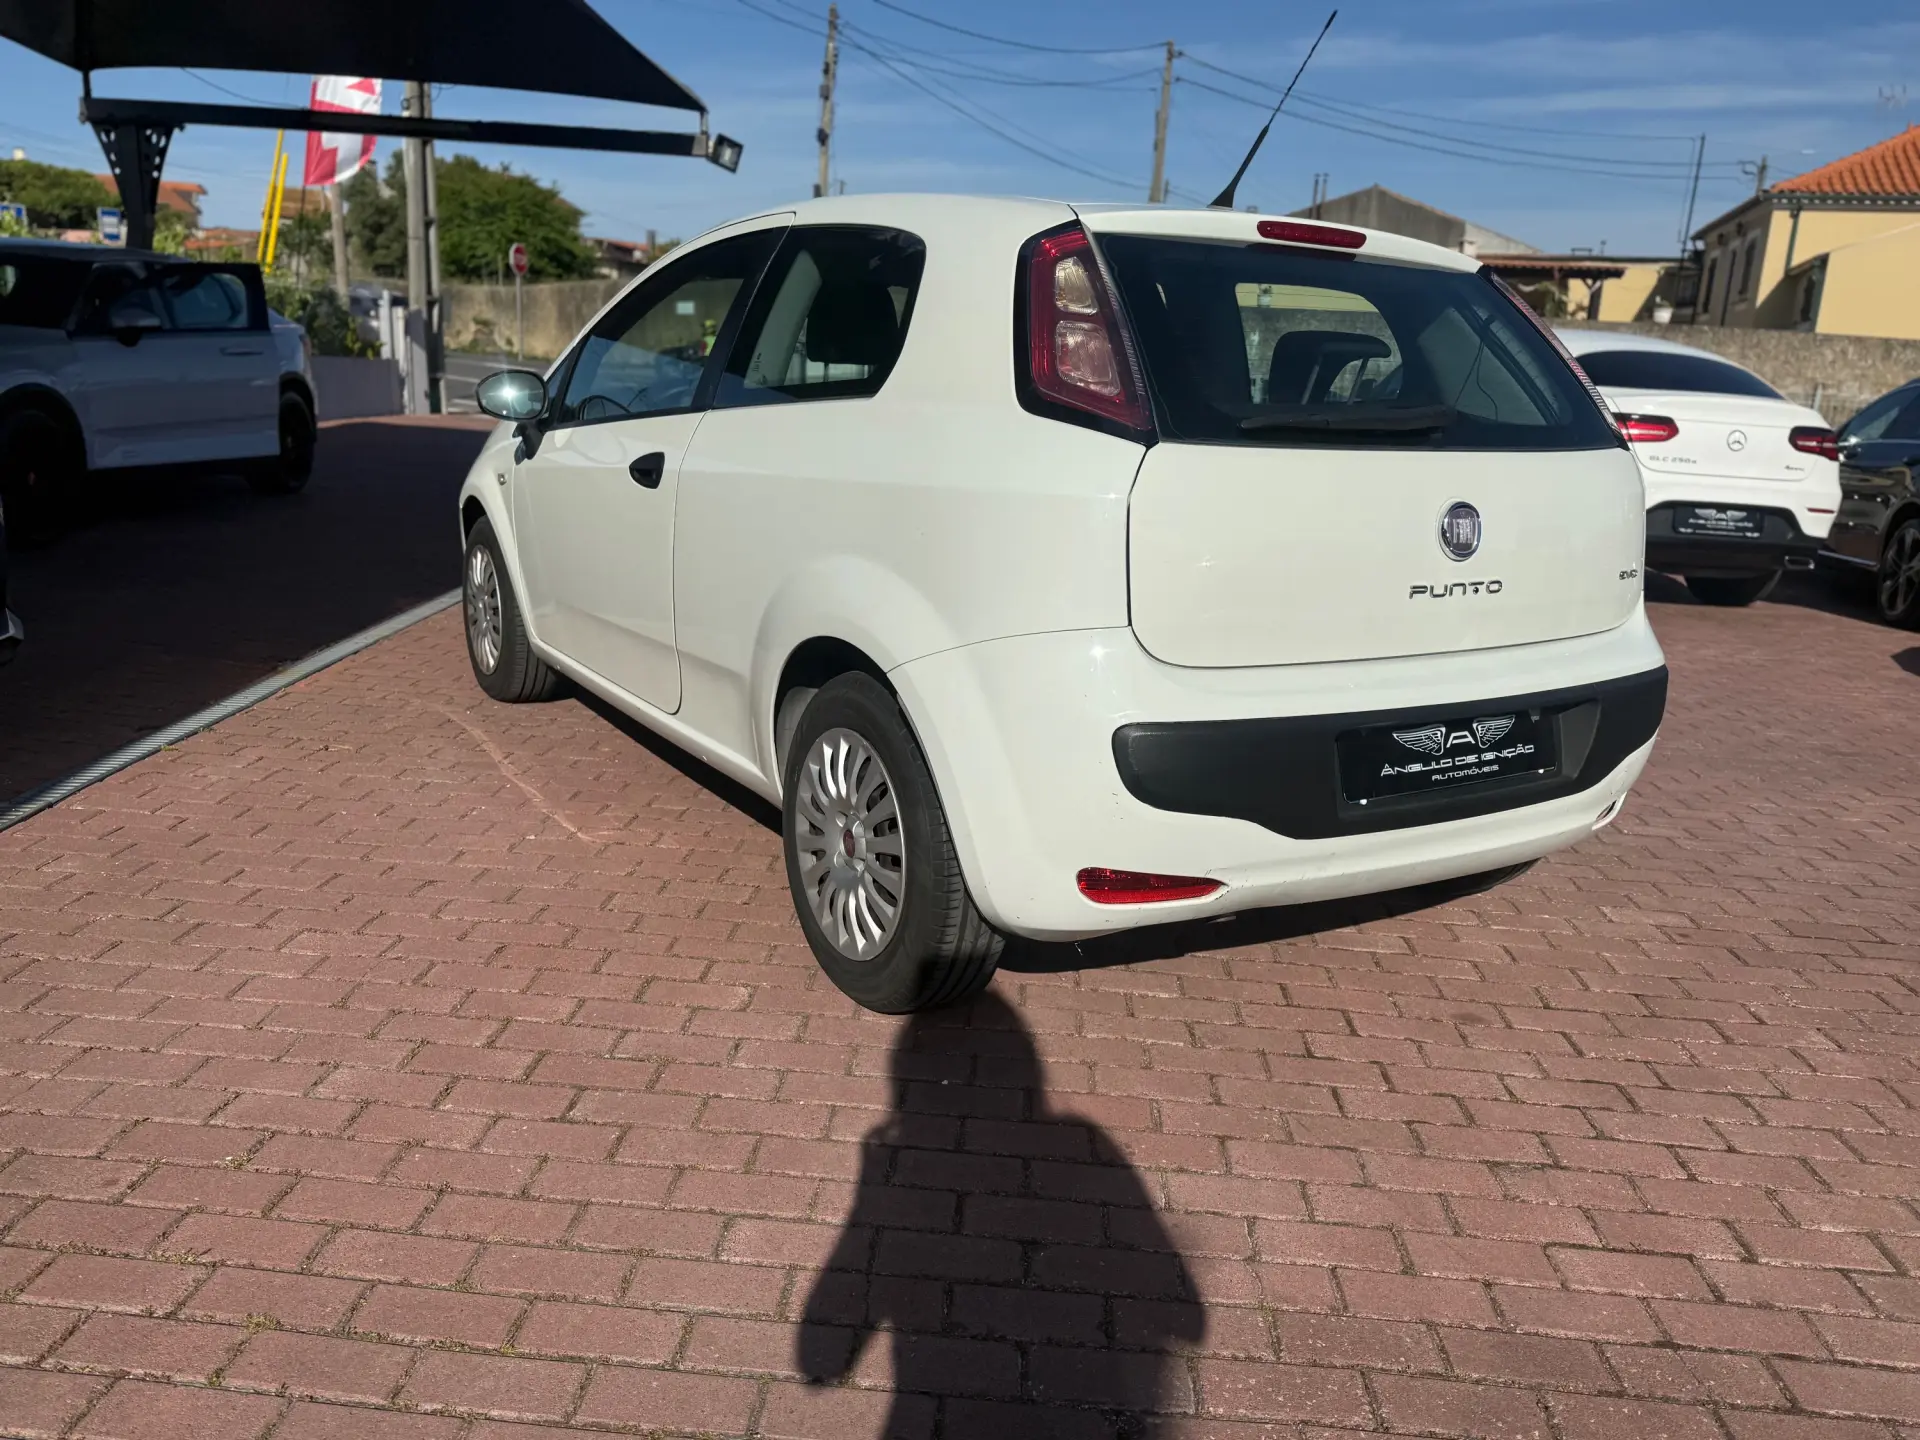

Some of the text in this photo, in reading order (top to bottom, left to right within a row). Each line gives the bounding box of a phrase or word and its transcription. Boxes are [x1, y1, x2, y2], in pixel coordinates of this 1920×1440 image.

[1408, 580, 1503, 599] PUNTO
[1380, 744, 1535, 777] ÂNGULO DE IGNIÇÃO
[1431, 764, 1500, 782] AUTOMÓVEIS
